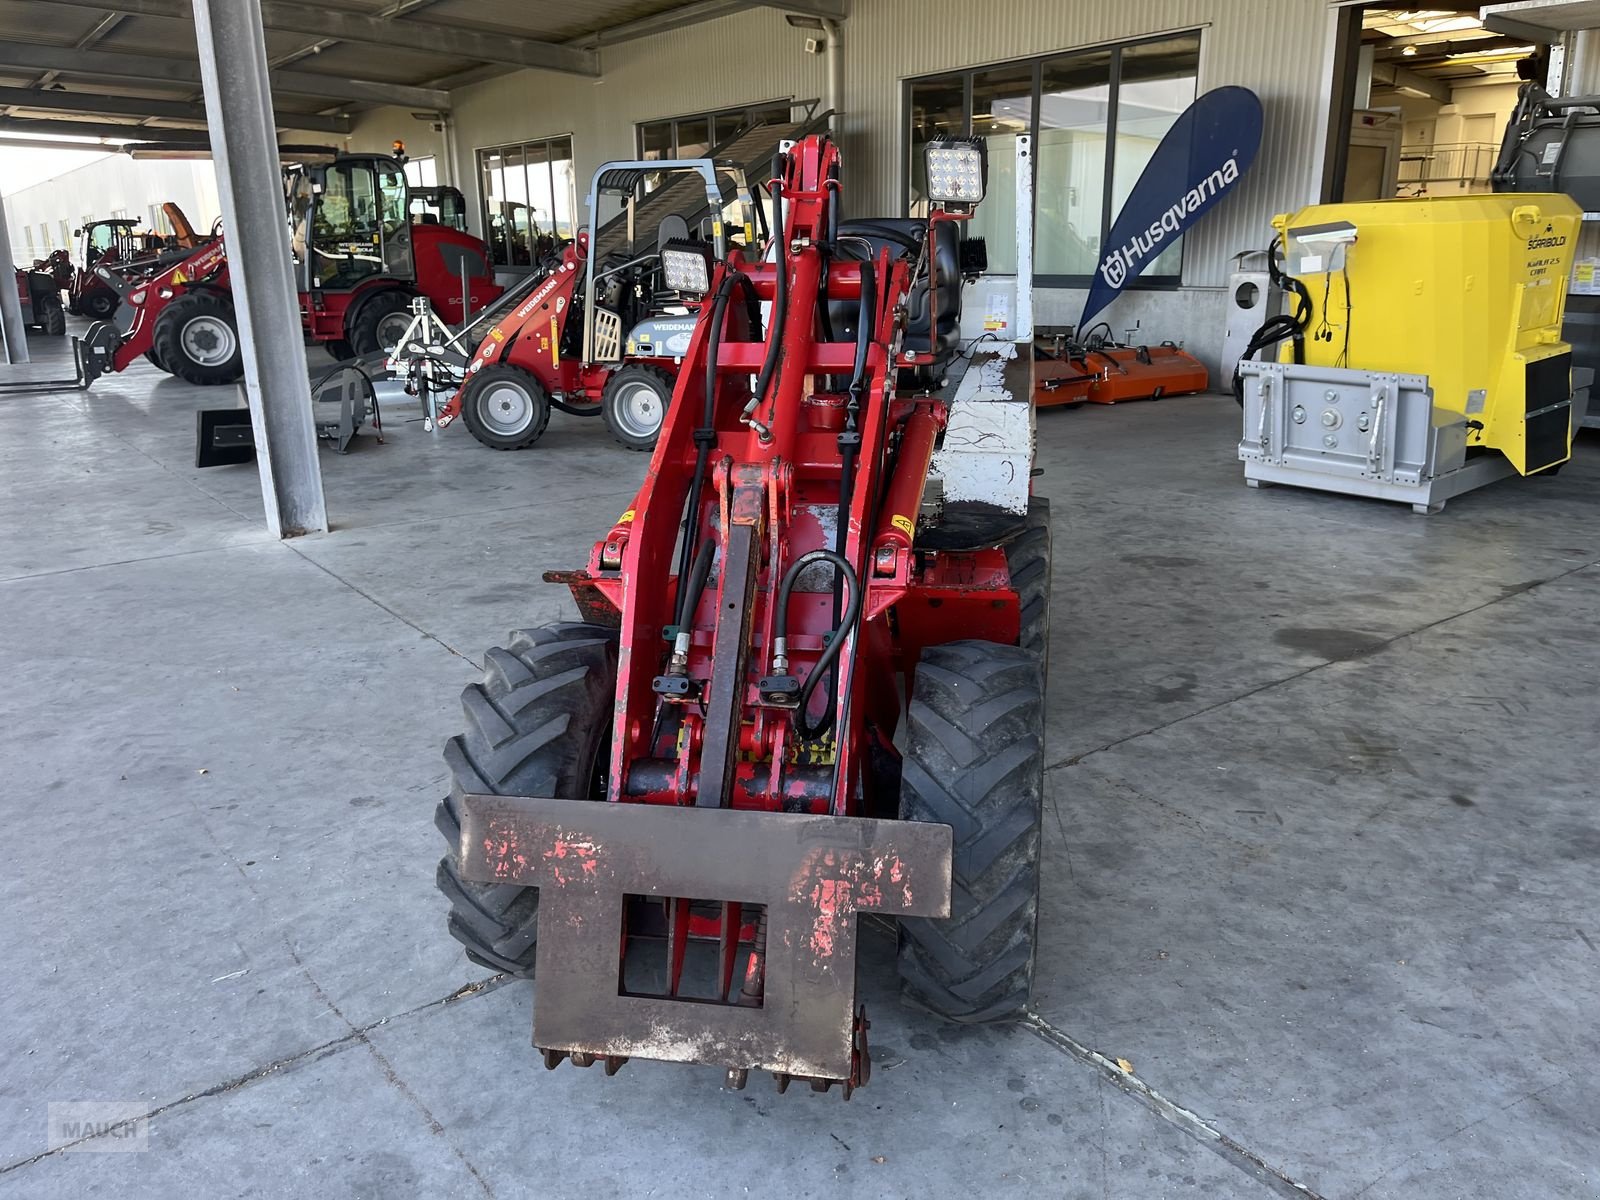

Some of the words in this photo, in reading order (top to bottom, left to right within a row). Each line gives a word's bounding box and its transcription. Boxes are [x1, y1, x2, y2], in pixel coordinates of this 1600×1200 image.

[1121, 157, 1239, 268] Husqvarna
[517, 279, 558, 318] WEIDEMANN
[653, 323, 696, 331] WEIDEMAN
